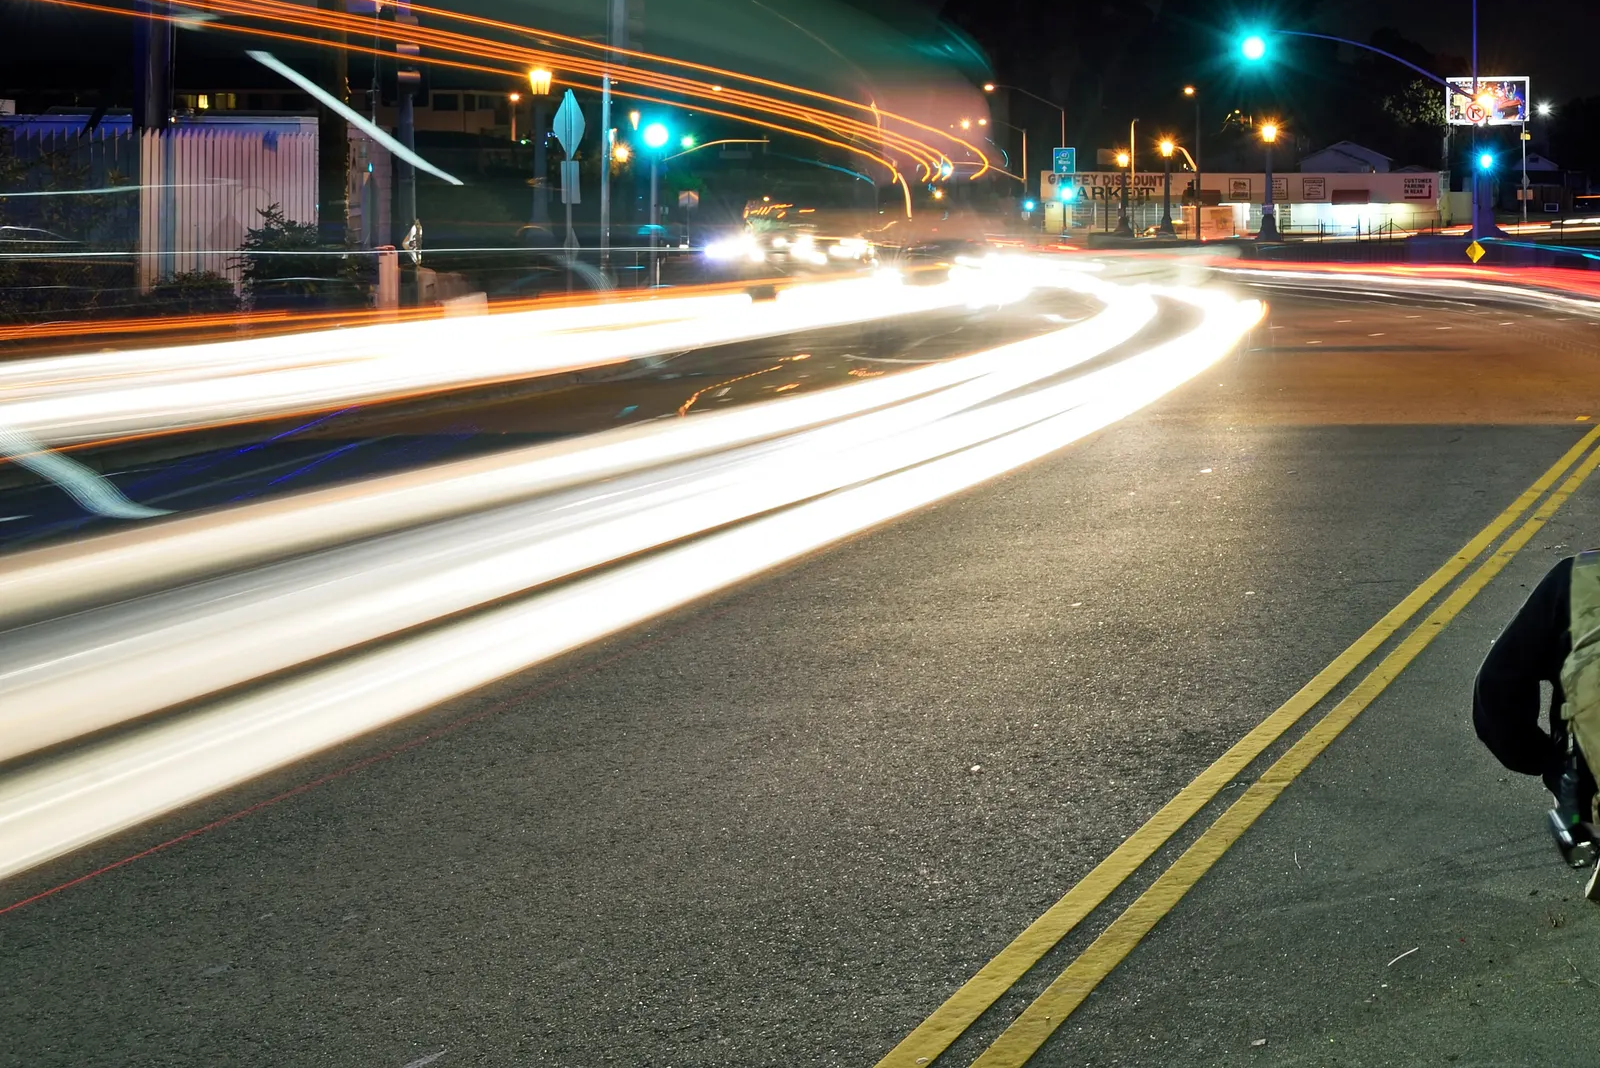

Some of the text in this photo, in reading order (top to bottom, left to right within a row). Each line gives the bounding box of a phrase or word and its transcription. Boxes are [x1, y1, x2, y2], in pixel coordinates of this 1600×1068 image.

[1048, 174, 1165, 187] GFEY DISCOUNT
[1068, 186, 1156, 201] ARKET
